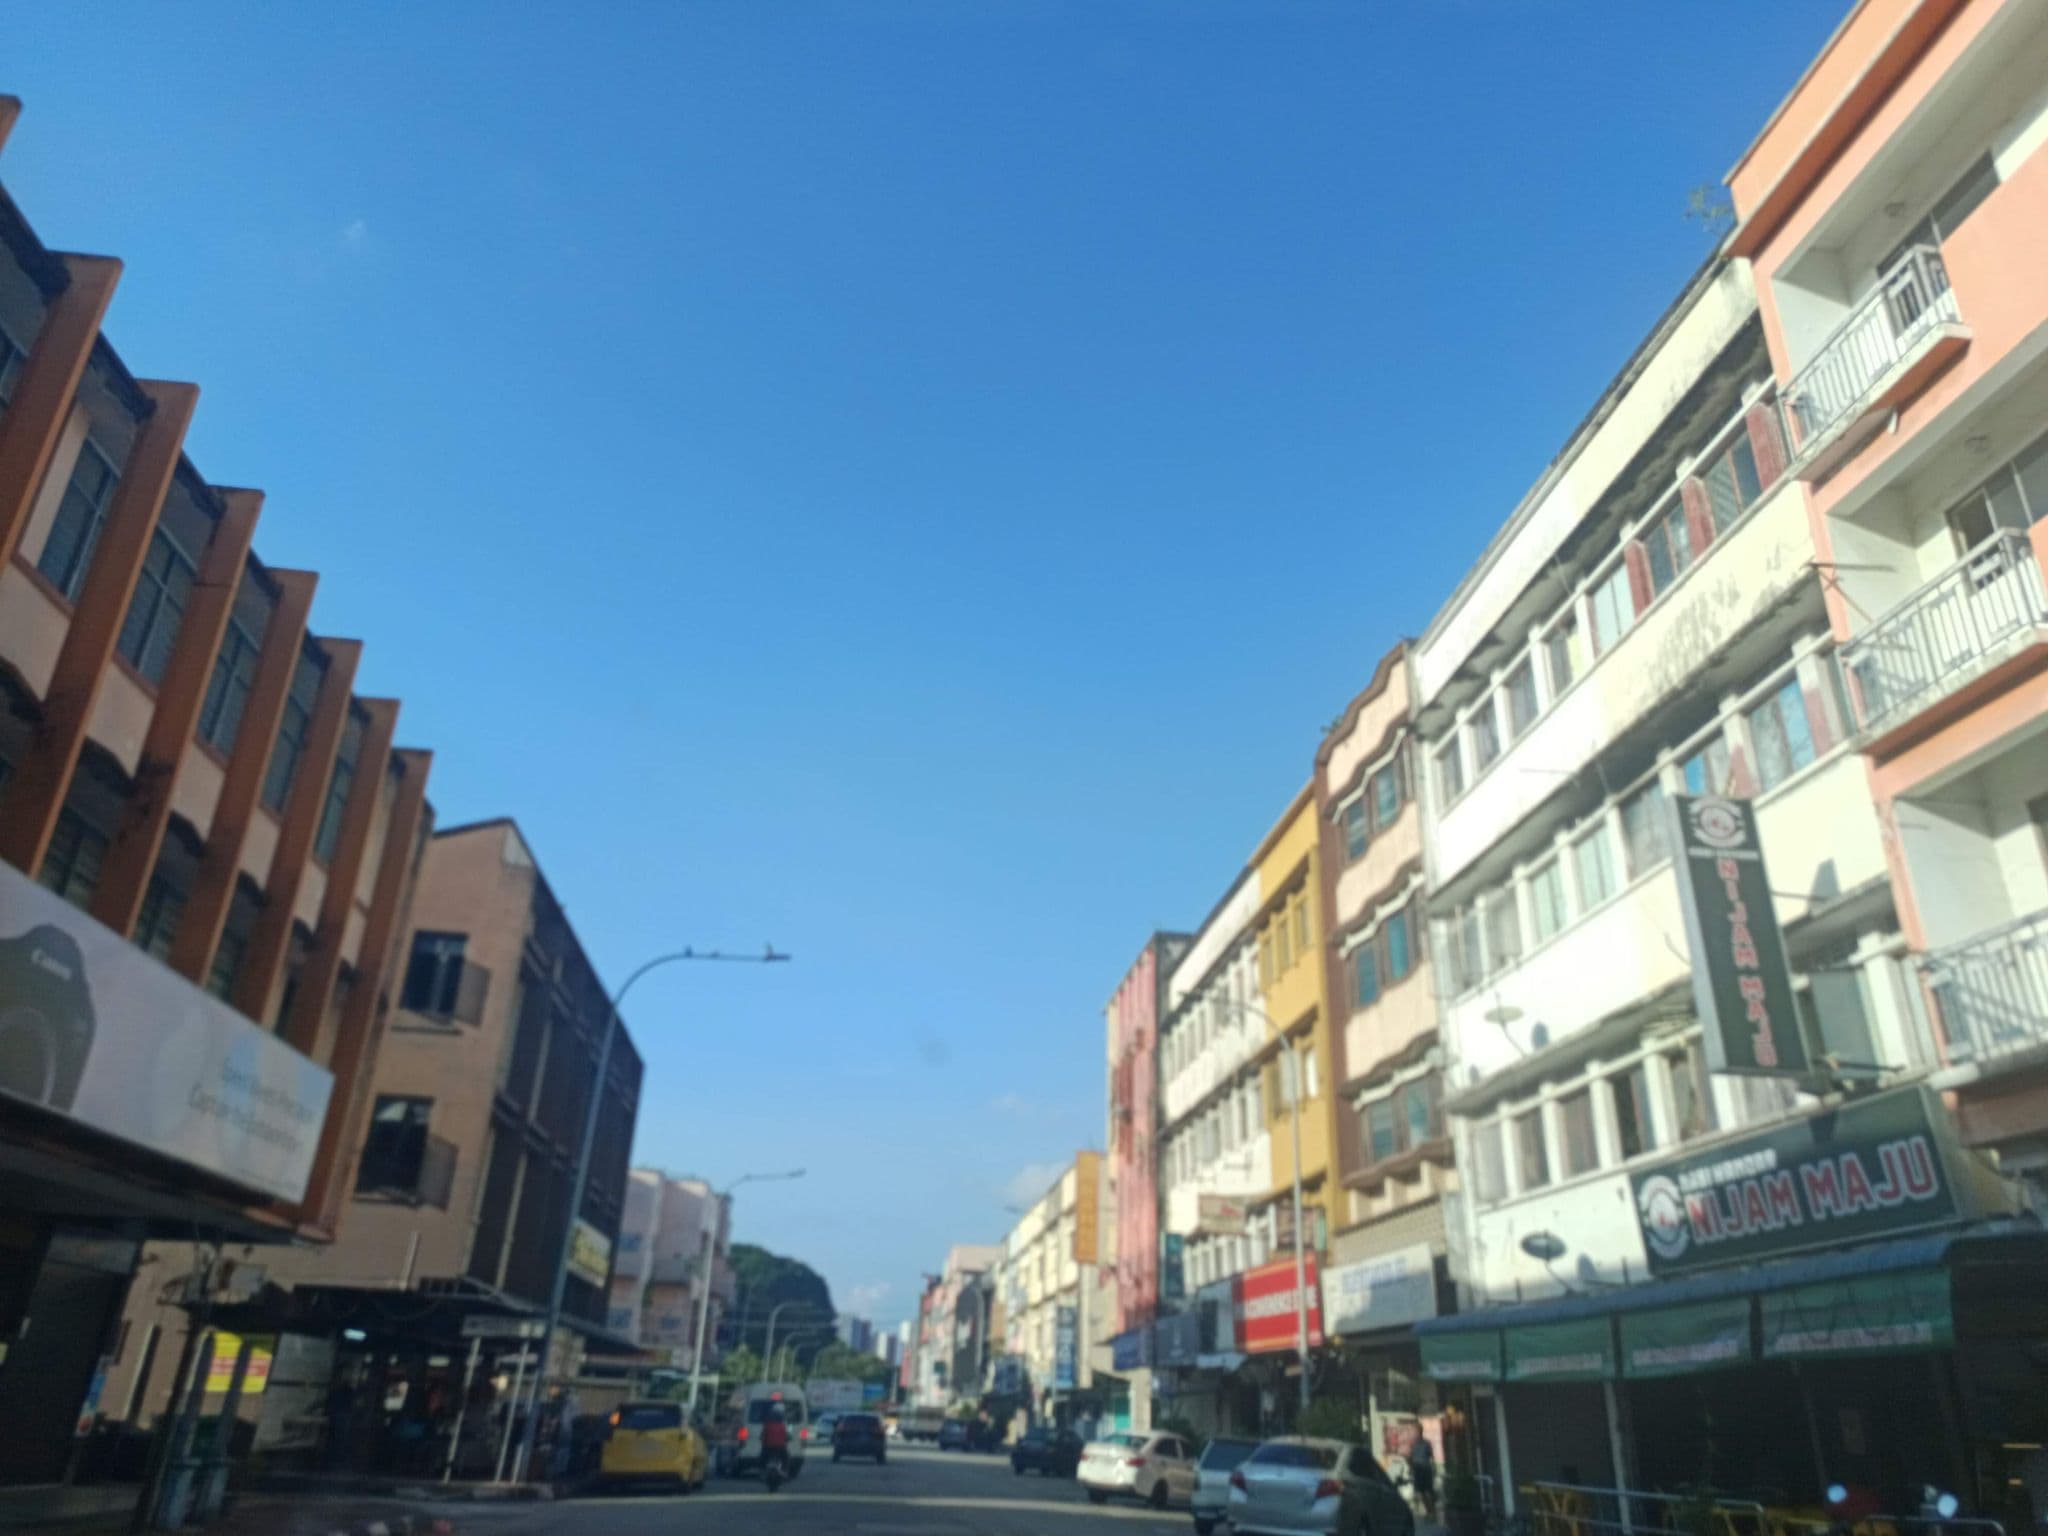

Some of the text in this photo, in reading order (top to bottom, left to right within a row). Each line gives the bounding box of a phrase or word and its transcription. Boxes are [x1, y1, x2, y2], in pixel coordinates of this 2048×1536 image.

[1717, 858, 1759, 968] NIJAM
[1685, 1170, 1803, 1244] NIJAM
[1800, 1136, 1938, 1221] MAJU
